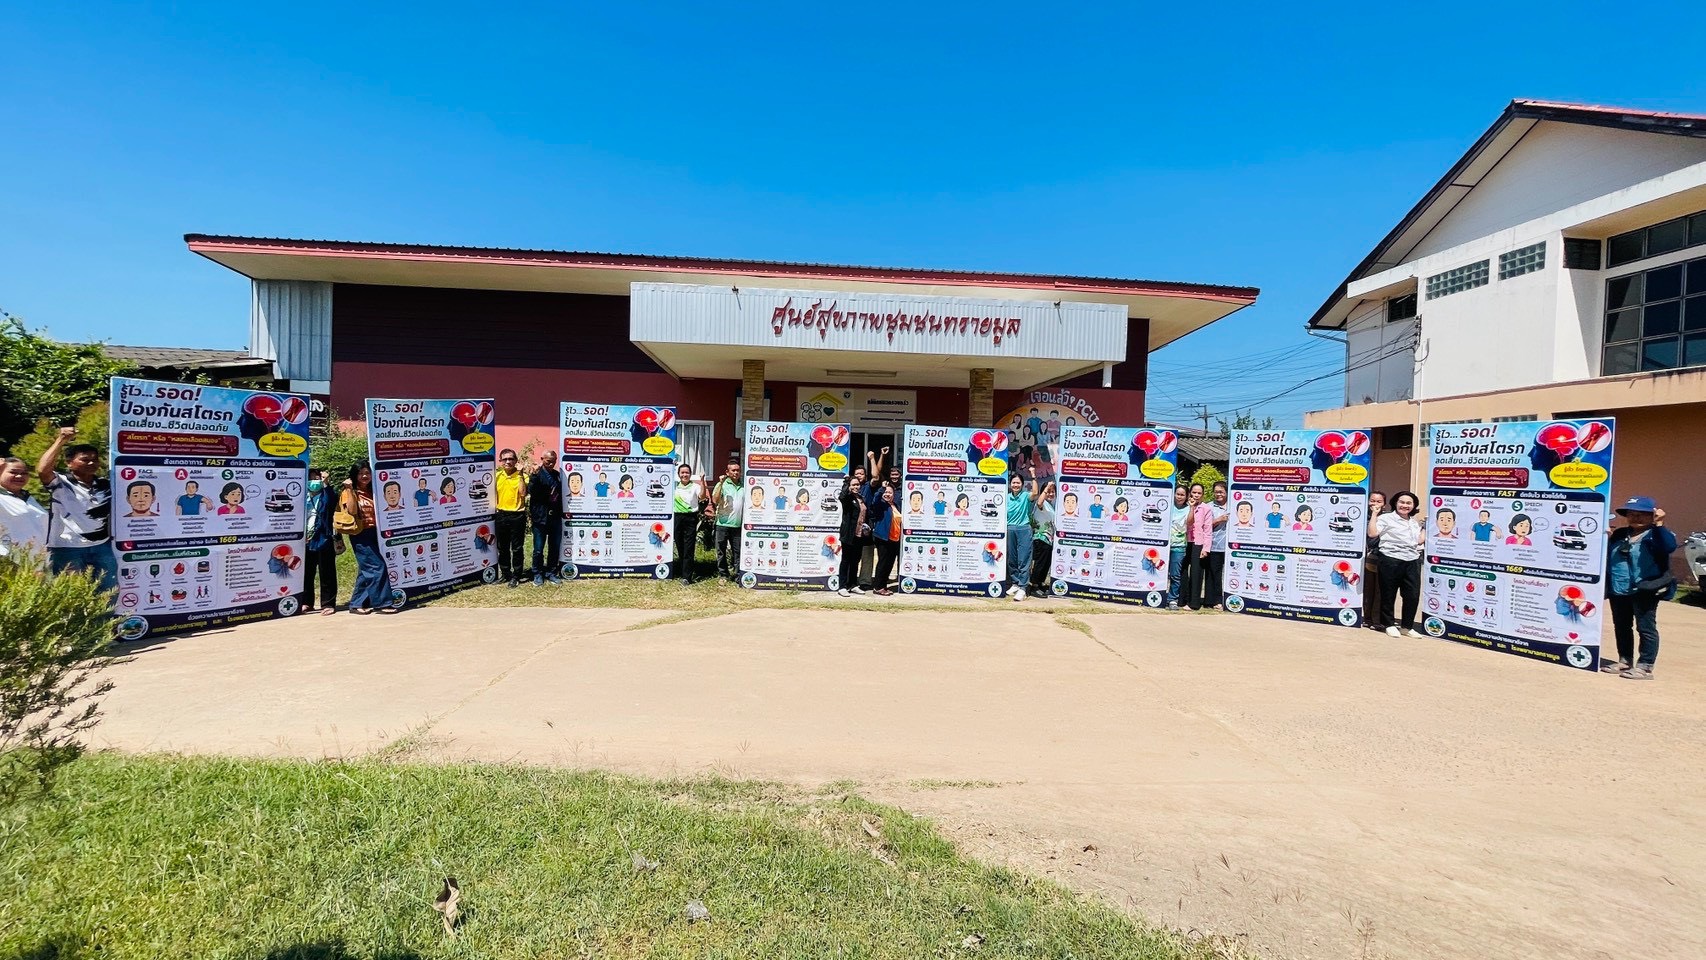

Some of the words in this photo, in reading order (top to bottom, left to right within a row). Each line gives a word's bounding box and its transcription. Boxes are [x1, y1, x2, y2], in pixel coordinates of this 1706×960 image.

[771, 297, 1021, 346] ศูนย์สุขภาพชุมชนทรายมูล
[155, 384, 201, 400] รอด!
[119, 399, 232, 421] ป้องกันสโตรก
[394, 401, 423, 412] รอด!
[583, 405, 608, 415] รอด!
[1074, 398, 1099, 424] PCU
[372, 415, 444, 429] ป้องกันสโตรก
[565, 417, 627, 429] ป้องกันสโตรก
[1082, 428, 1107, 437] รอด!
[1255, 431, 1285, 441] รอด!
[1460, 425, 1496, 437] รอด!
[1063, 439, 1125, 452] ป้องกันสโตรก
[1234, 444, 1307, 456] ป้องกันสโตรก
[1434, 440, 1524, 454] ป้องกันสโตรก
[206, 458, 226, 466] FAST
[219, 535, 236, 543] 1669
[1506, 564, 1523, 573] 1669
